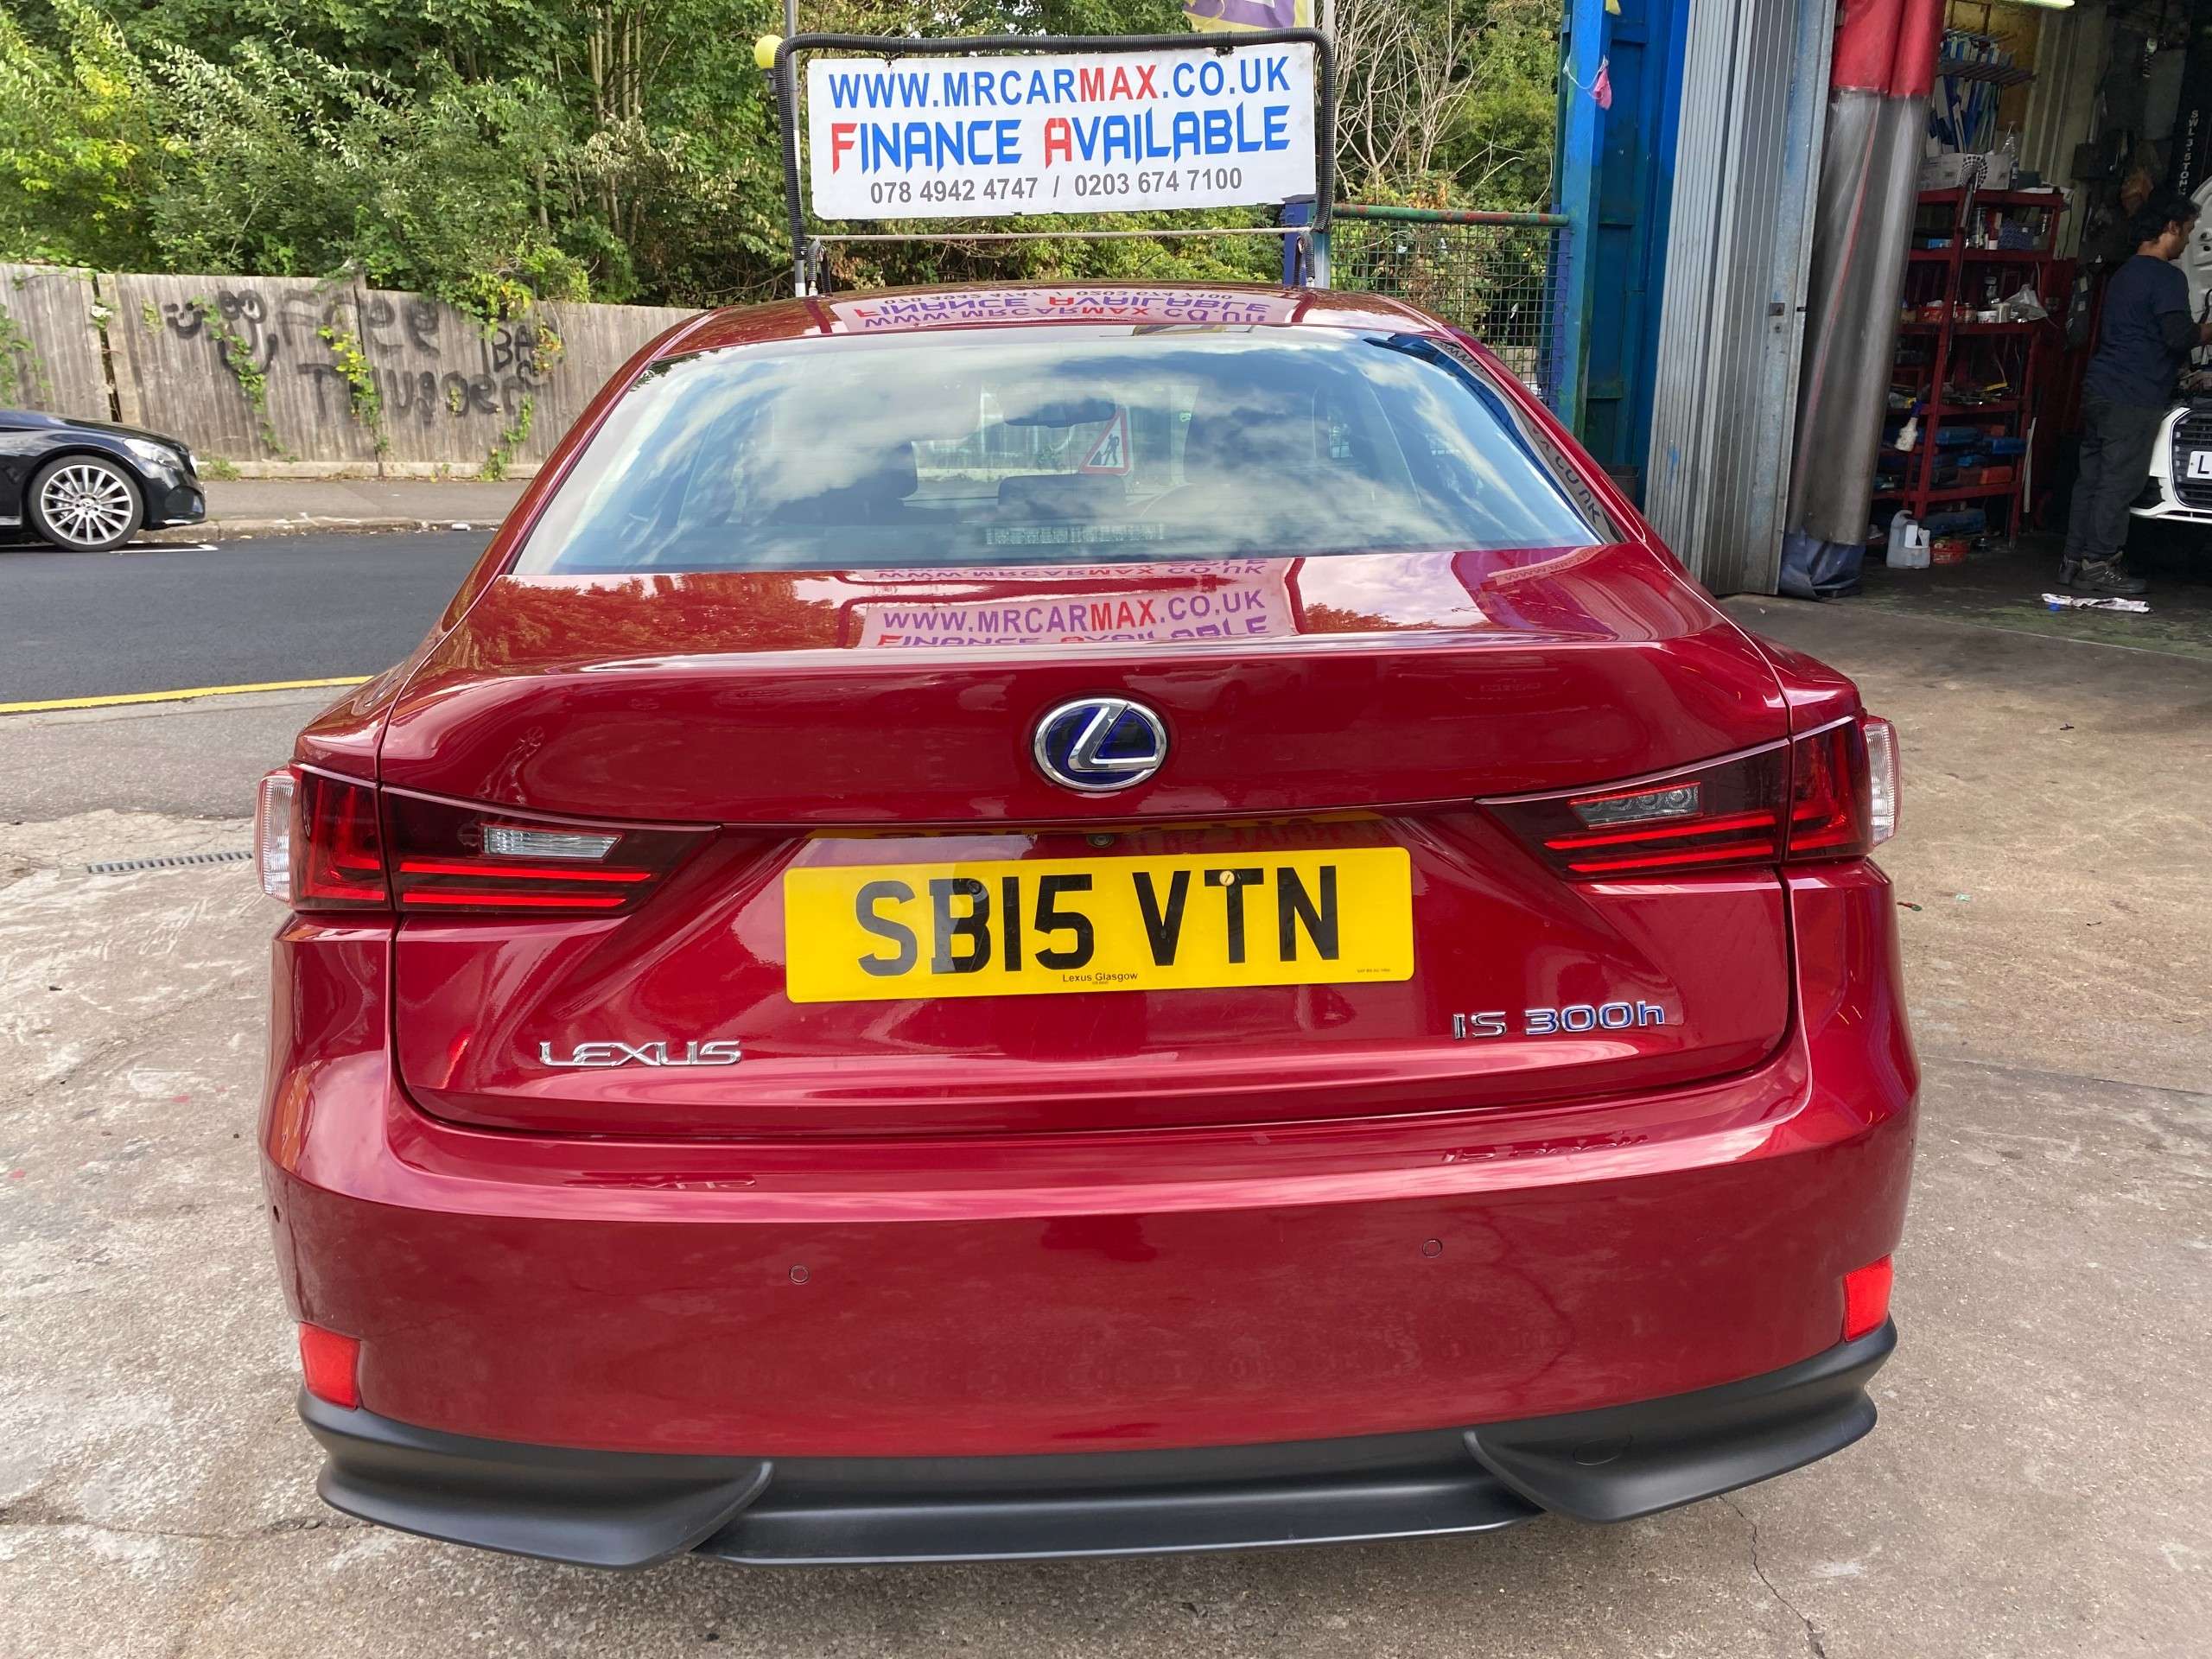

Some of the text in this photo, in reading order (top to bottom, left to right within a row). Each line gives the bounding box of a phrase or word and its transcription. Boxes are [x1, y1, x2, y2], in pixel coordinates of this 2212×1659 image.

[829, 55, 1291, 109] WWW.MRCARMAX.CO.UK
[831, 101, 1291, 175] FINANCE AVAILABLE
[870, 167, 1243, 204] 078 4942 4747 / 0203 674 7100
[855, 865, 1340, 976] SB15 VTN
[1063, 972, 1138, 982] Lexus Glasgow
[1452, 1000, 1665, 1039] IS 300h
[539, 1040, 742, 1067] LEXUS
